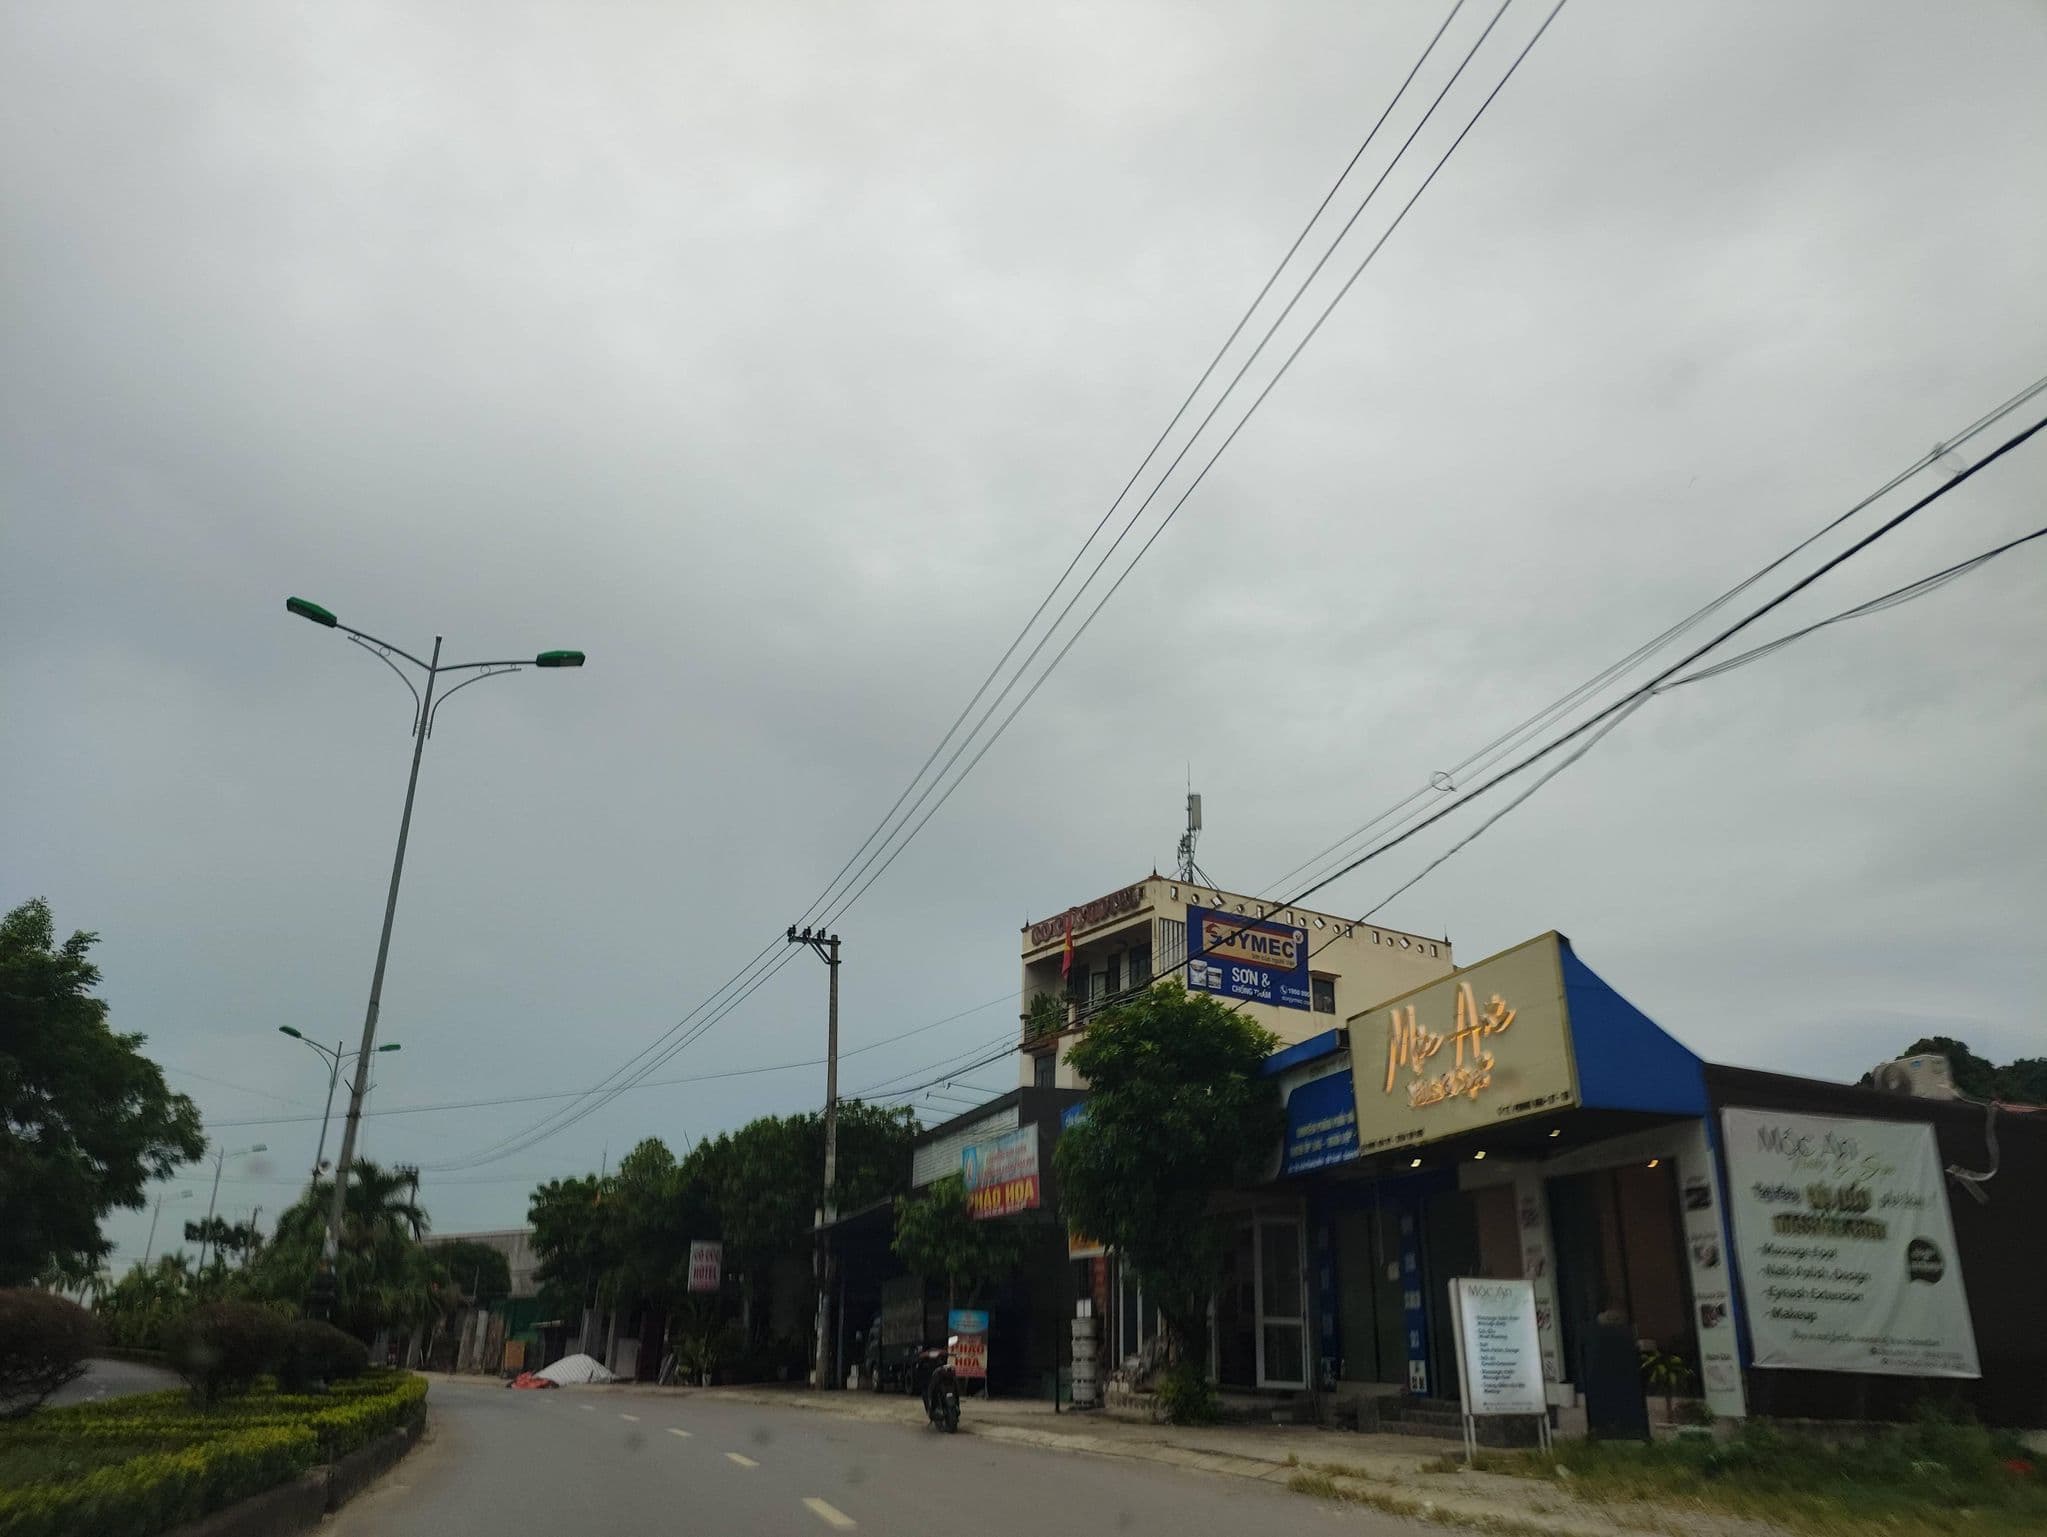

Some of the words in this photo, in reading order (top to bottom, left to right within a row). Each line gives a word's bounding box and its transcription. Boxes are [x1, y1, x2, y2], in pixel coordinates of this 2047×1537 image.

[1232, 967, 1258, 986] SƠN
[1261, 973, 1270, 988] &
[1005, 1178, 1034, 1206] HOA
